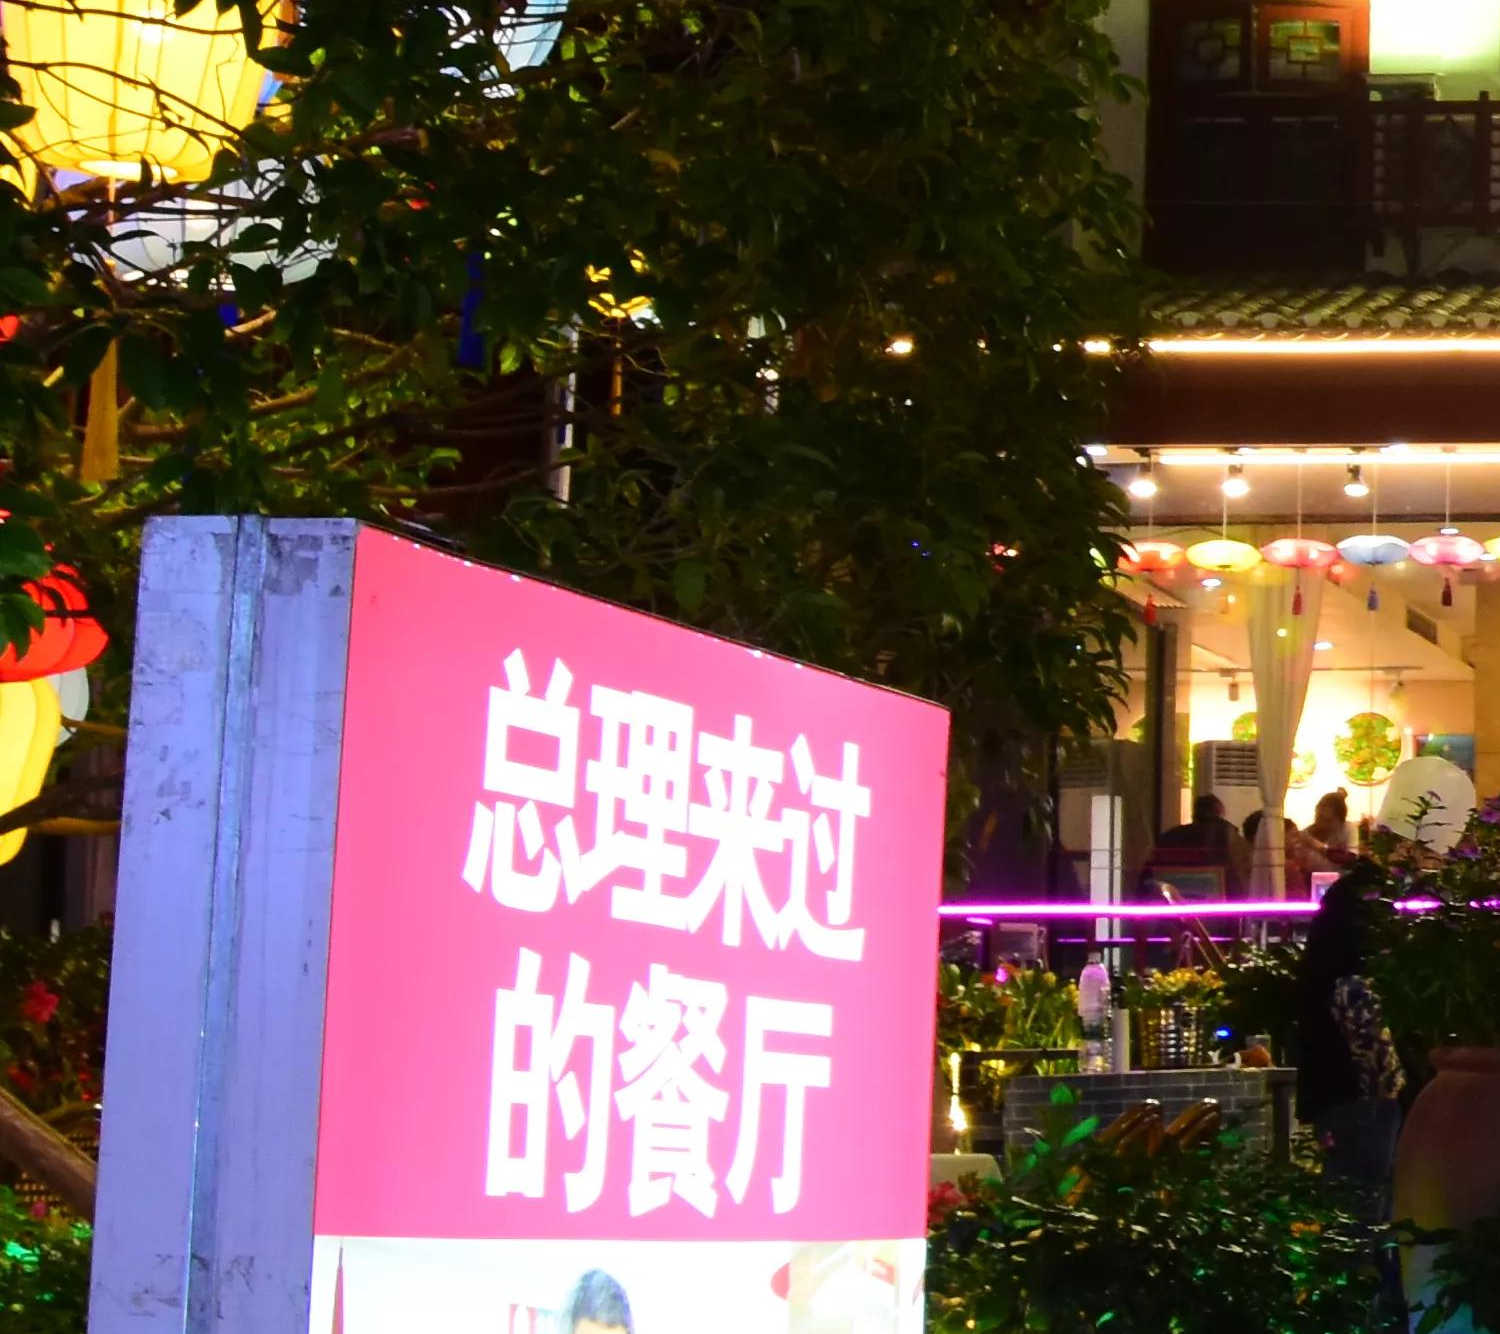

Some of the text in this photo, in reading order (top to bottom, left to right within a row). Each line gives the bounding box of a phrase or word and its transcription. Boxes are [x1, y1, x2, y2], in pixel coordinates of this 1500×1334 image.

[462, 647, 871, 962] 总理来过
[485, 947, 833, 1218] 的餐厅
